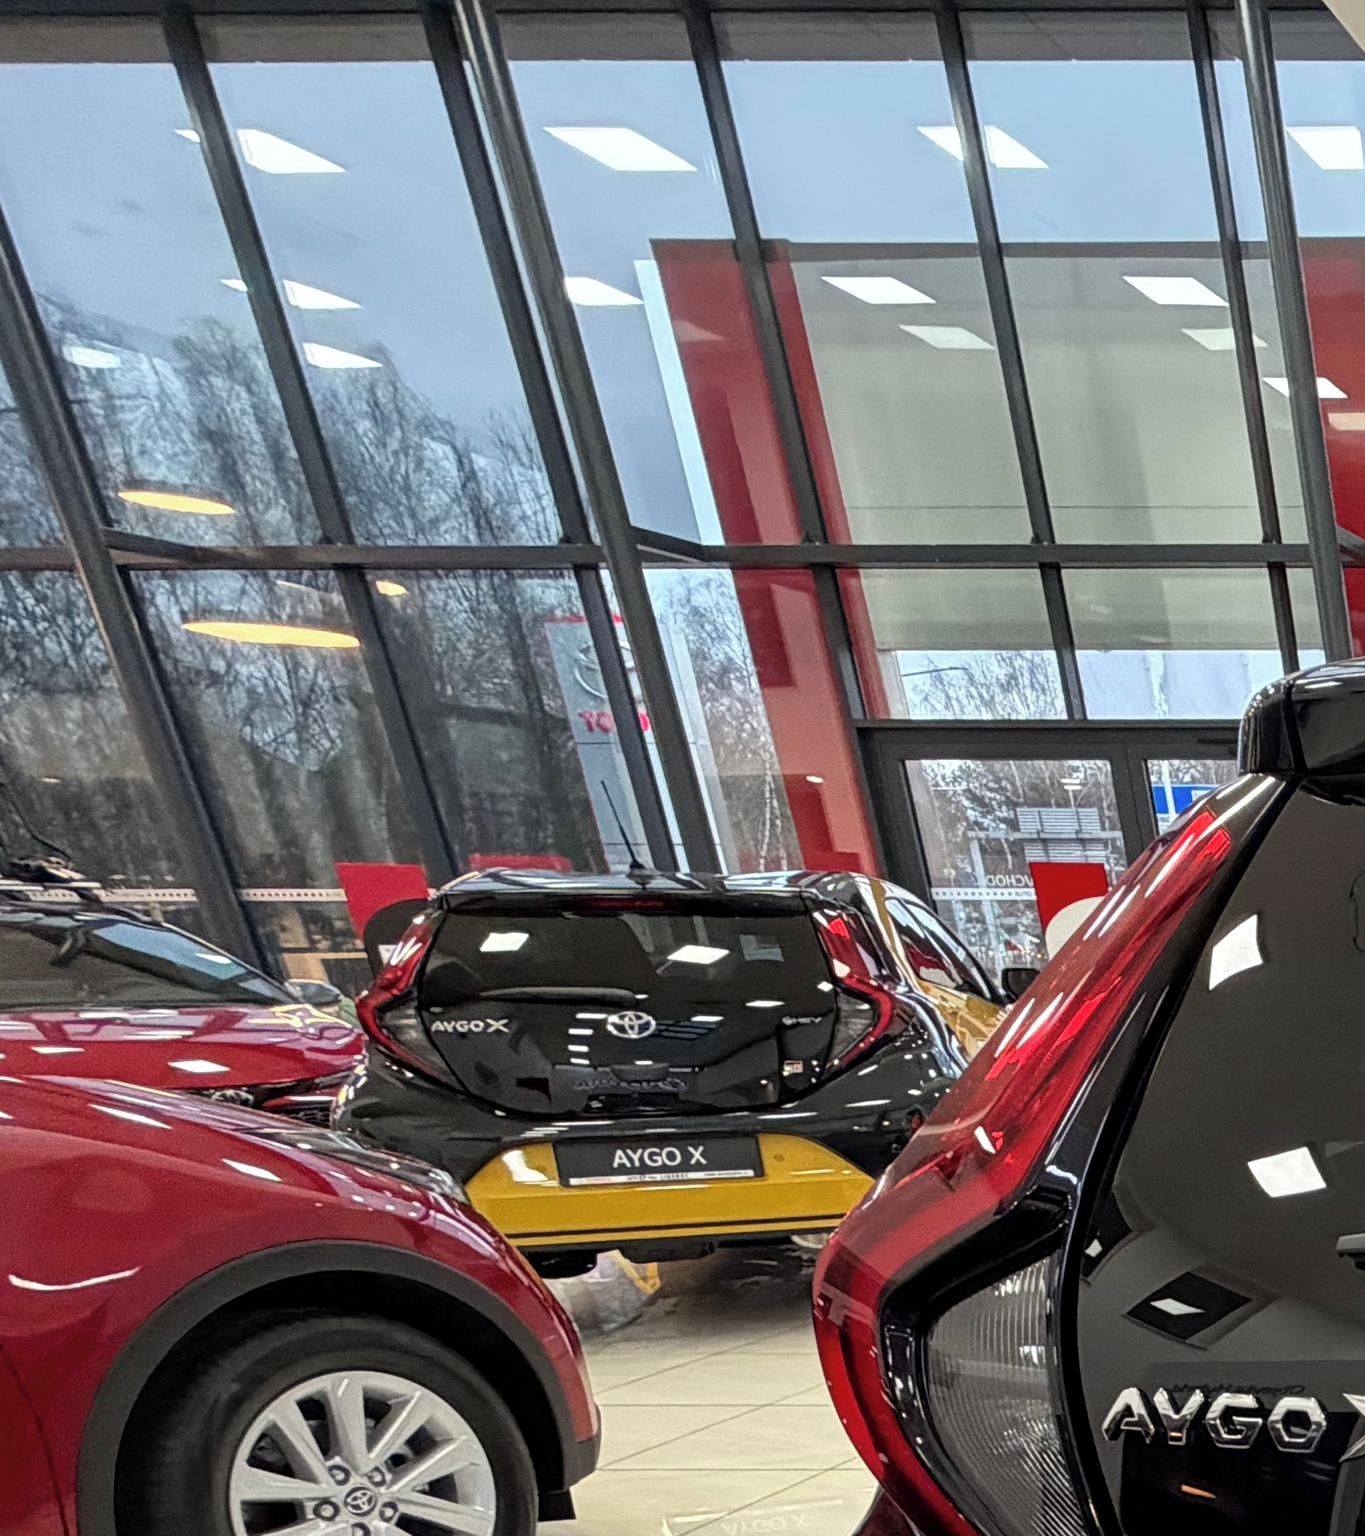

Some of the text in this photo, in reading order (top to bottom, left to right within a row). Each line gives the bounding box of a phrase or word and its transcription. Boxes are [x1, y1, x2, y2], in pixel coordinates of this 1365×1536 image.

[431, 1018, 510, 1034] AYGO X
[612, 1146, 708, 1169] AYGO X
[1101, 1386, 1327, 1453] AYGO
